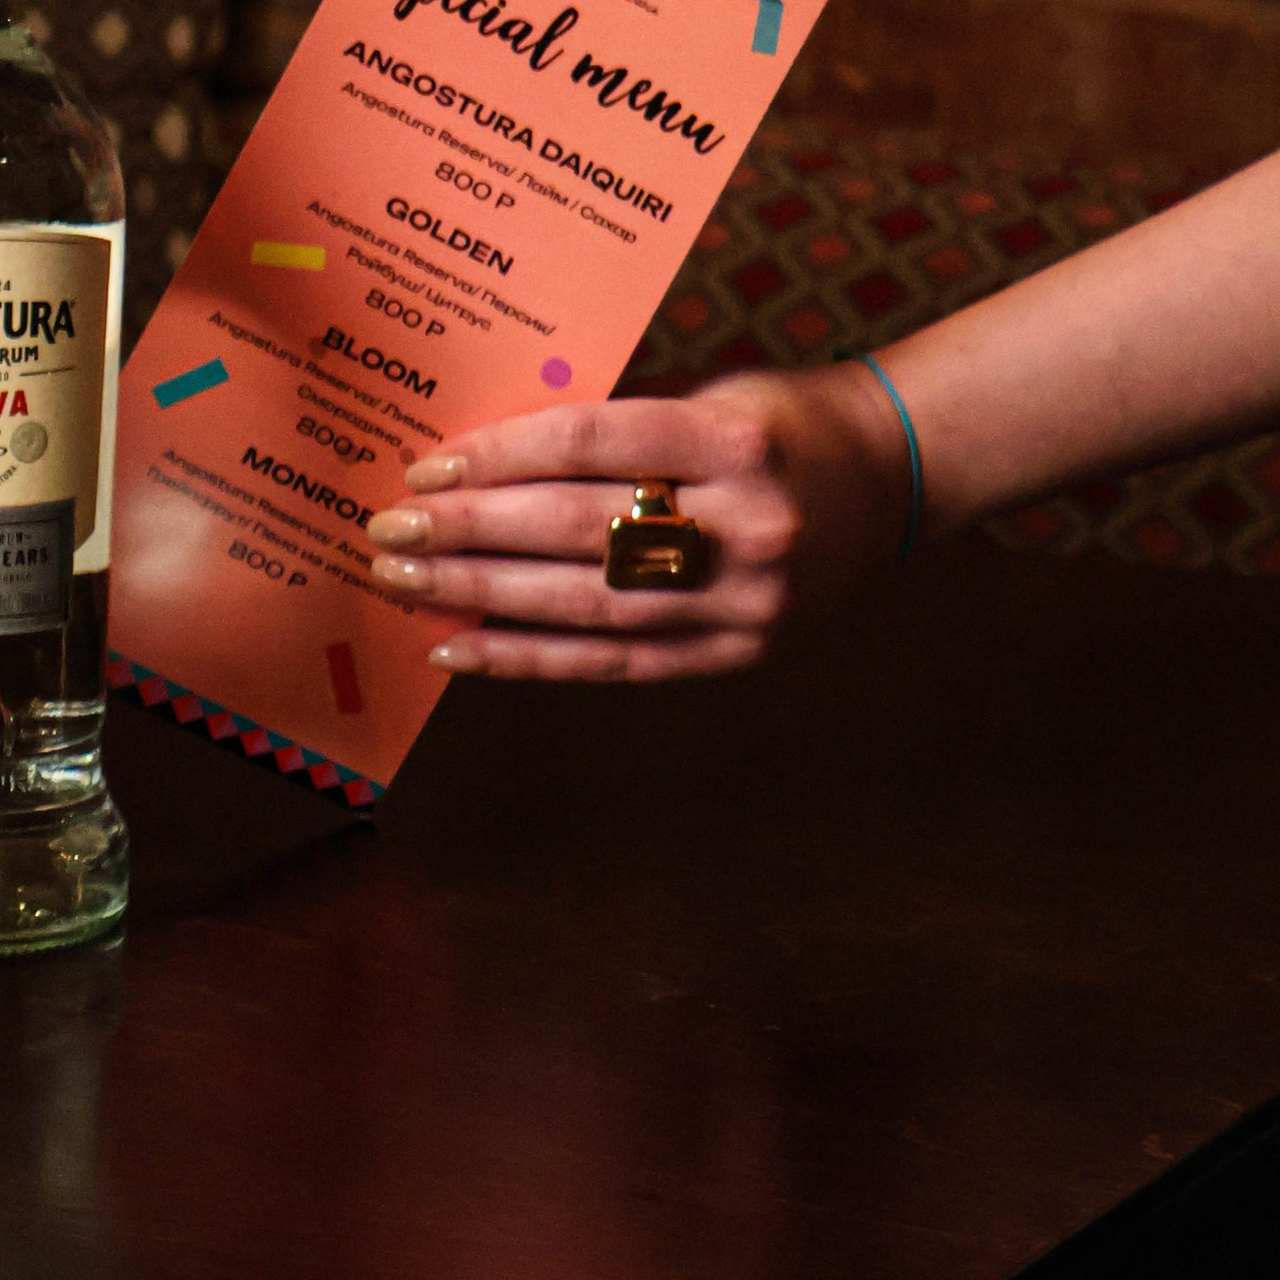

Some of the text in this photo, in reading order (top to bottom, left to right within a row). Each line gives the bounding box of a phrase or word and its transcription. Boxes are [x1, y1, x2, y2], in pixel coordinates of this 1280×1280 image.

[343, 39, 673, 223] ANGOSTURA DAIQUIRI
[570, 53, 725, 155] menu
[341, 81, 436, 138] Angostura
[580, 205, 638, 245] Сахар
[435, 160, 492, 202] 800
[305, 200, 401, 257] Angostura
[385, 196, 515, 276] GOLDEN
[364, 287, 423, 329] 800
[0, 346, 39, 367] RUM
[209, 311, 302, 369] Angostura
[321, 326, 438, 400] BLOOM
[295, 415, 354, 459] 800
[228, 538, 287, 581] 800
